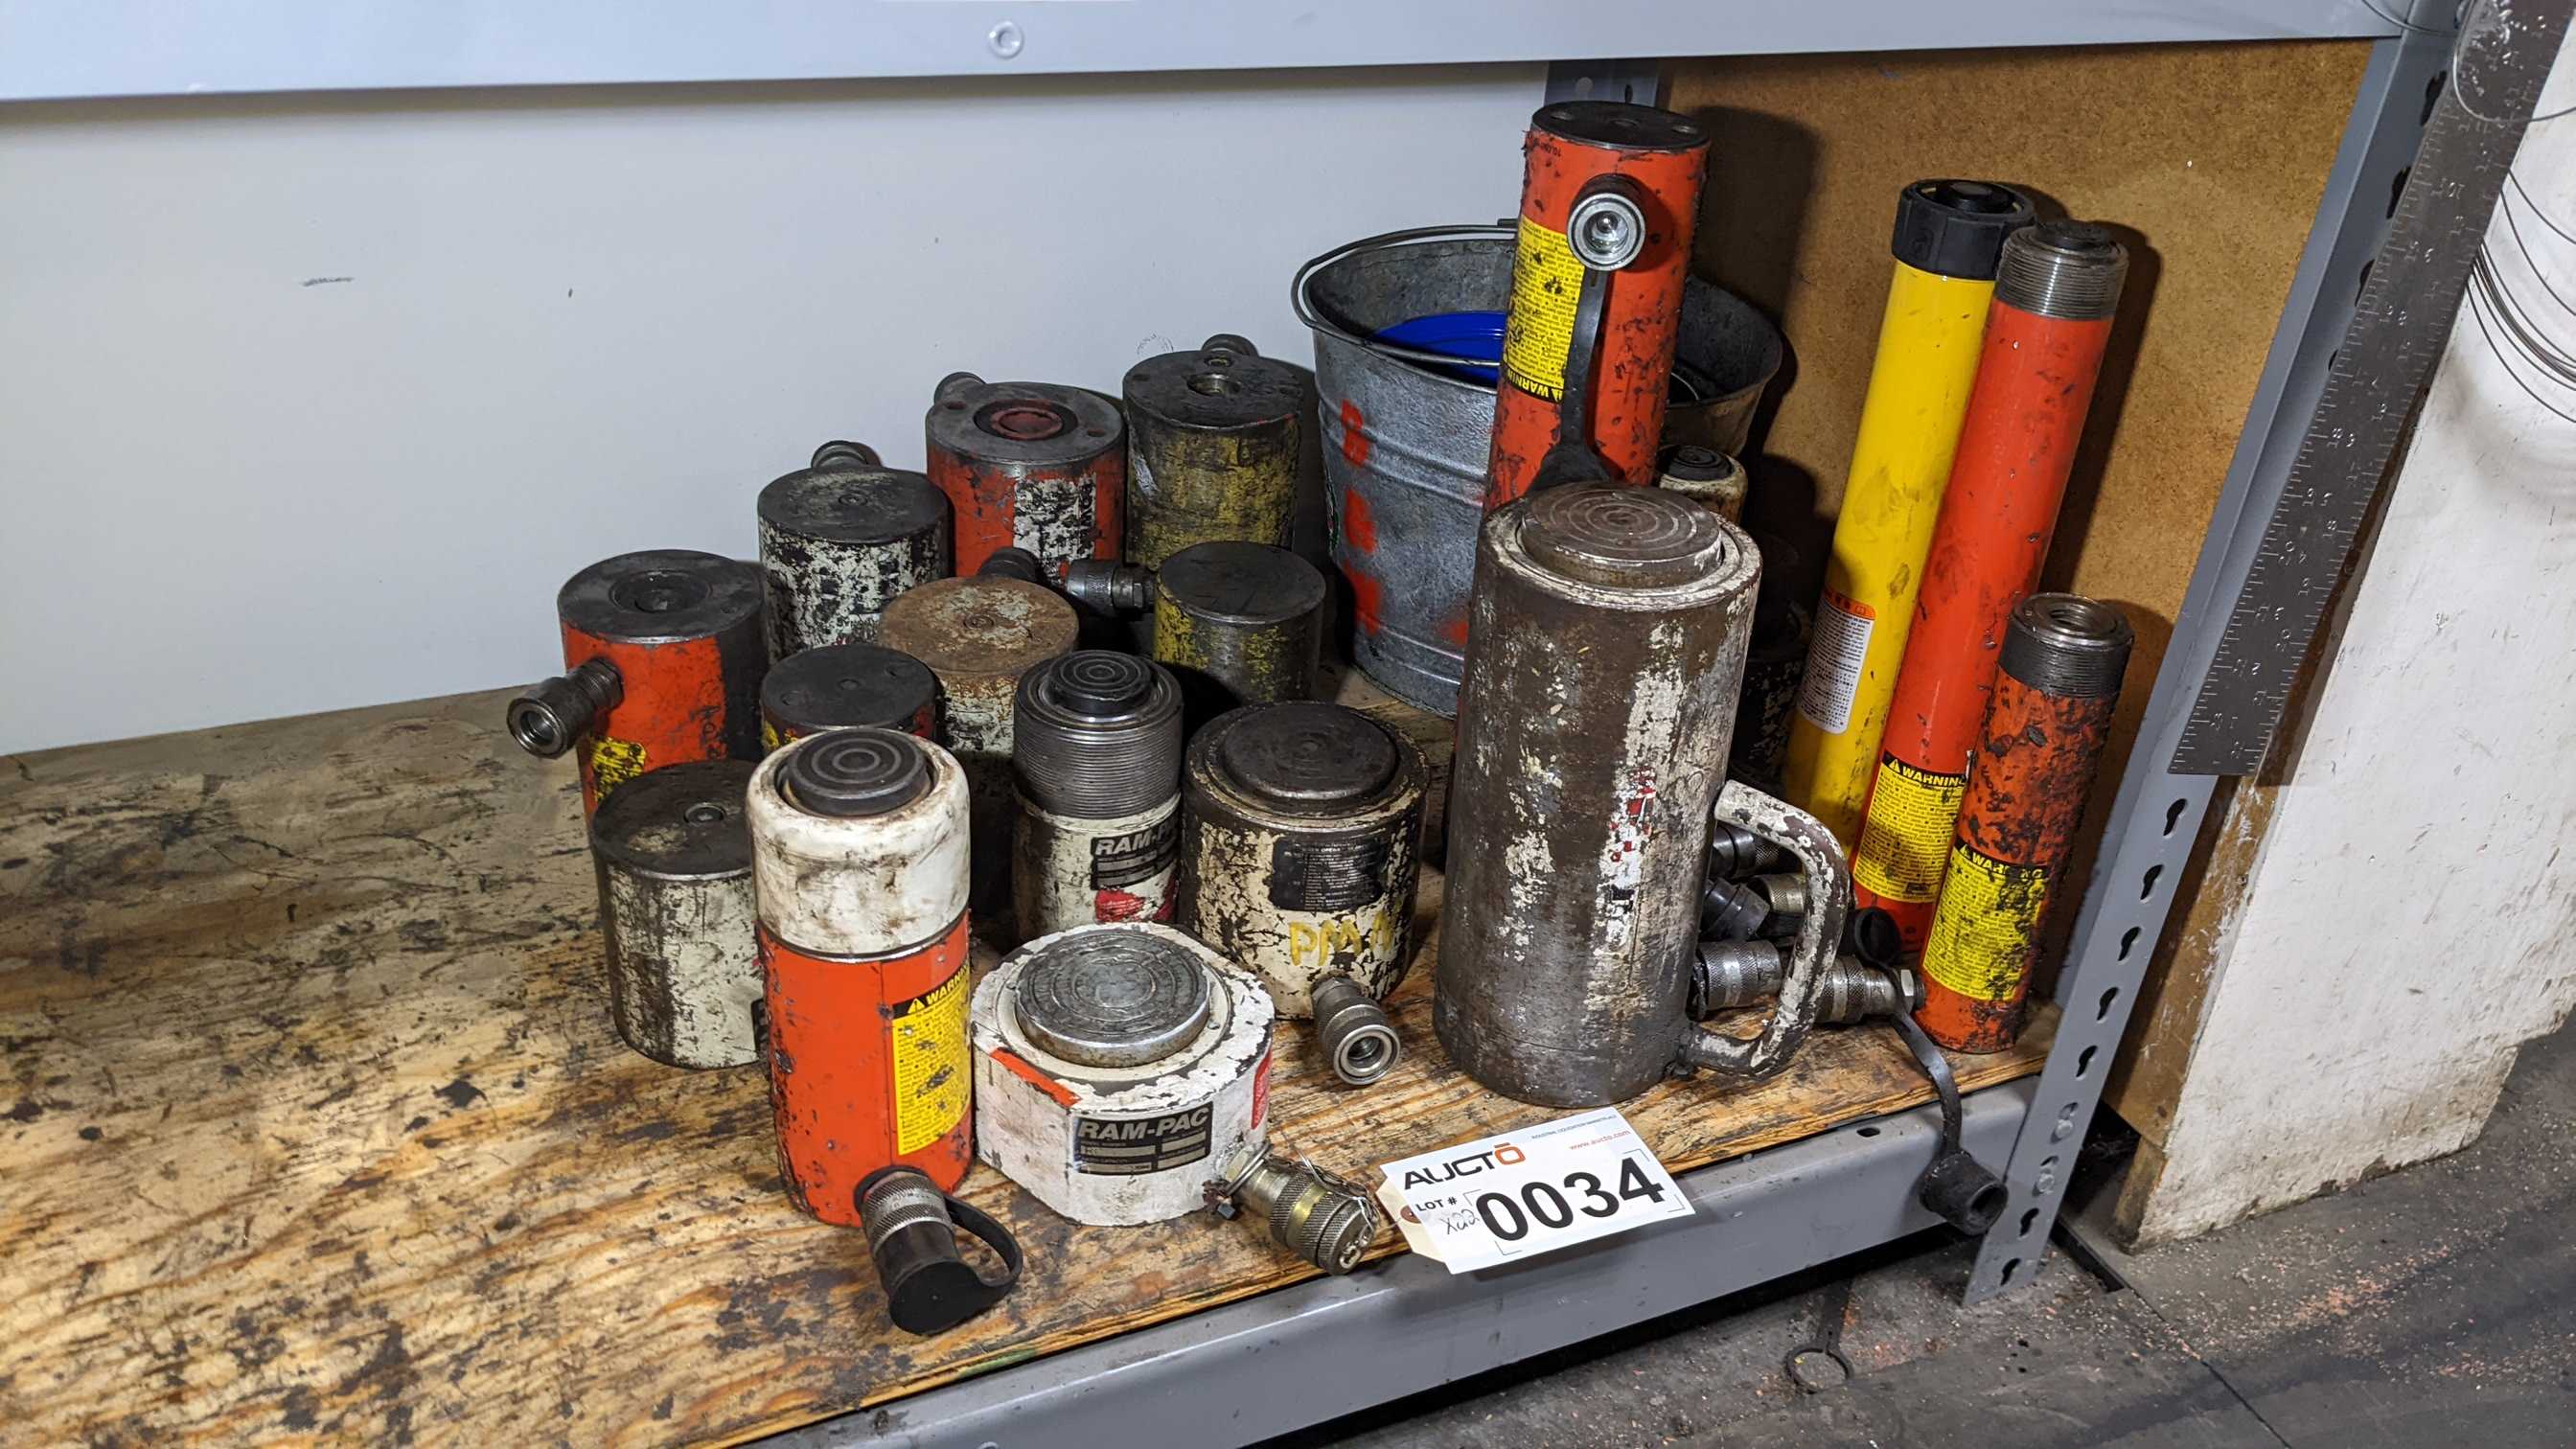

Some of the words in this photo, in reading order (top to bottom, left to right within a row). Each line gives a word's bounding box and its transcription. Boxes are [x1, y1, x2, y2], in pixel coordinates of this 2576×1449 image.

[1506, 368, 1550, 398] WARNIN
[1095, 823, 1171, 856] RAM-P
[926, 964, 968, 1005] WARNIN
[1077, 1106, 1209, 1140] RAM-PAC
[1569, 1130, 1631, 1150] www.aucto.com
[1415, 1199, 1444, 1212] LOT
[1476, 1157, 1666, 1241] 0034
